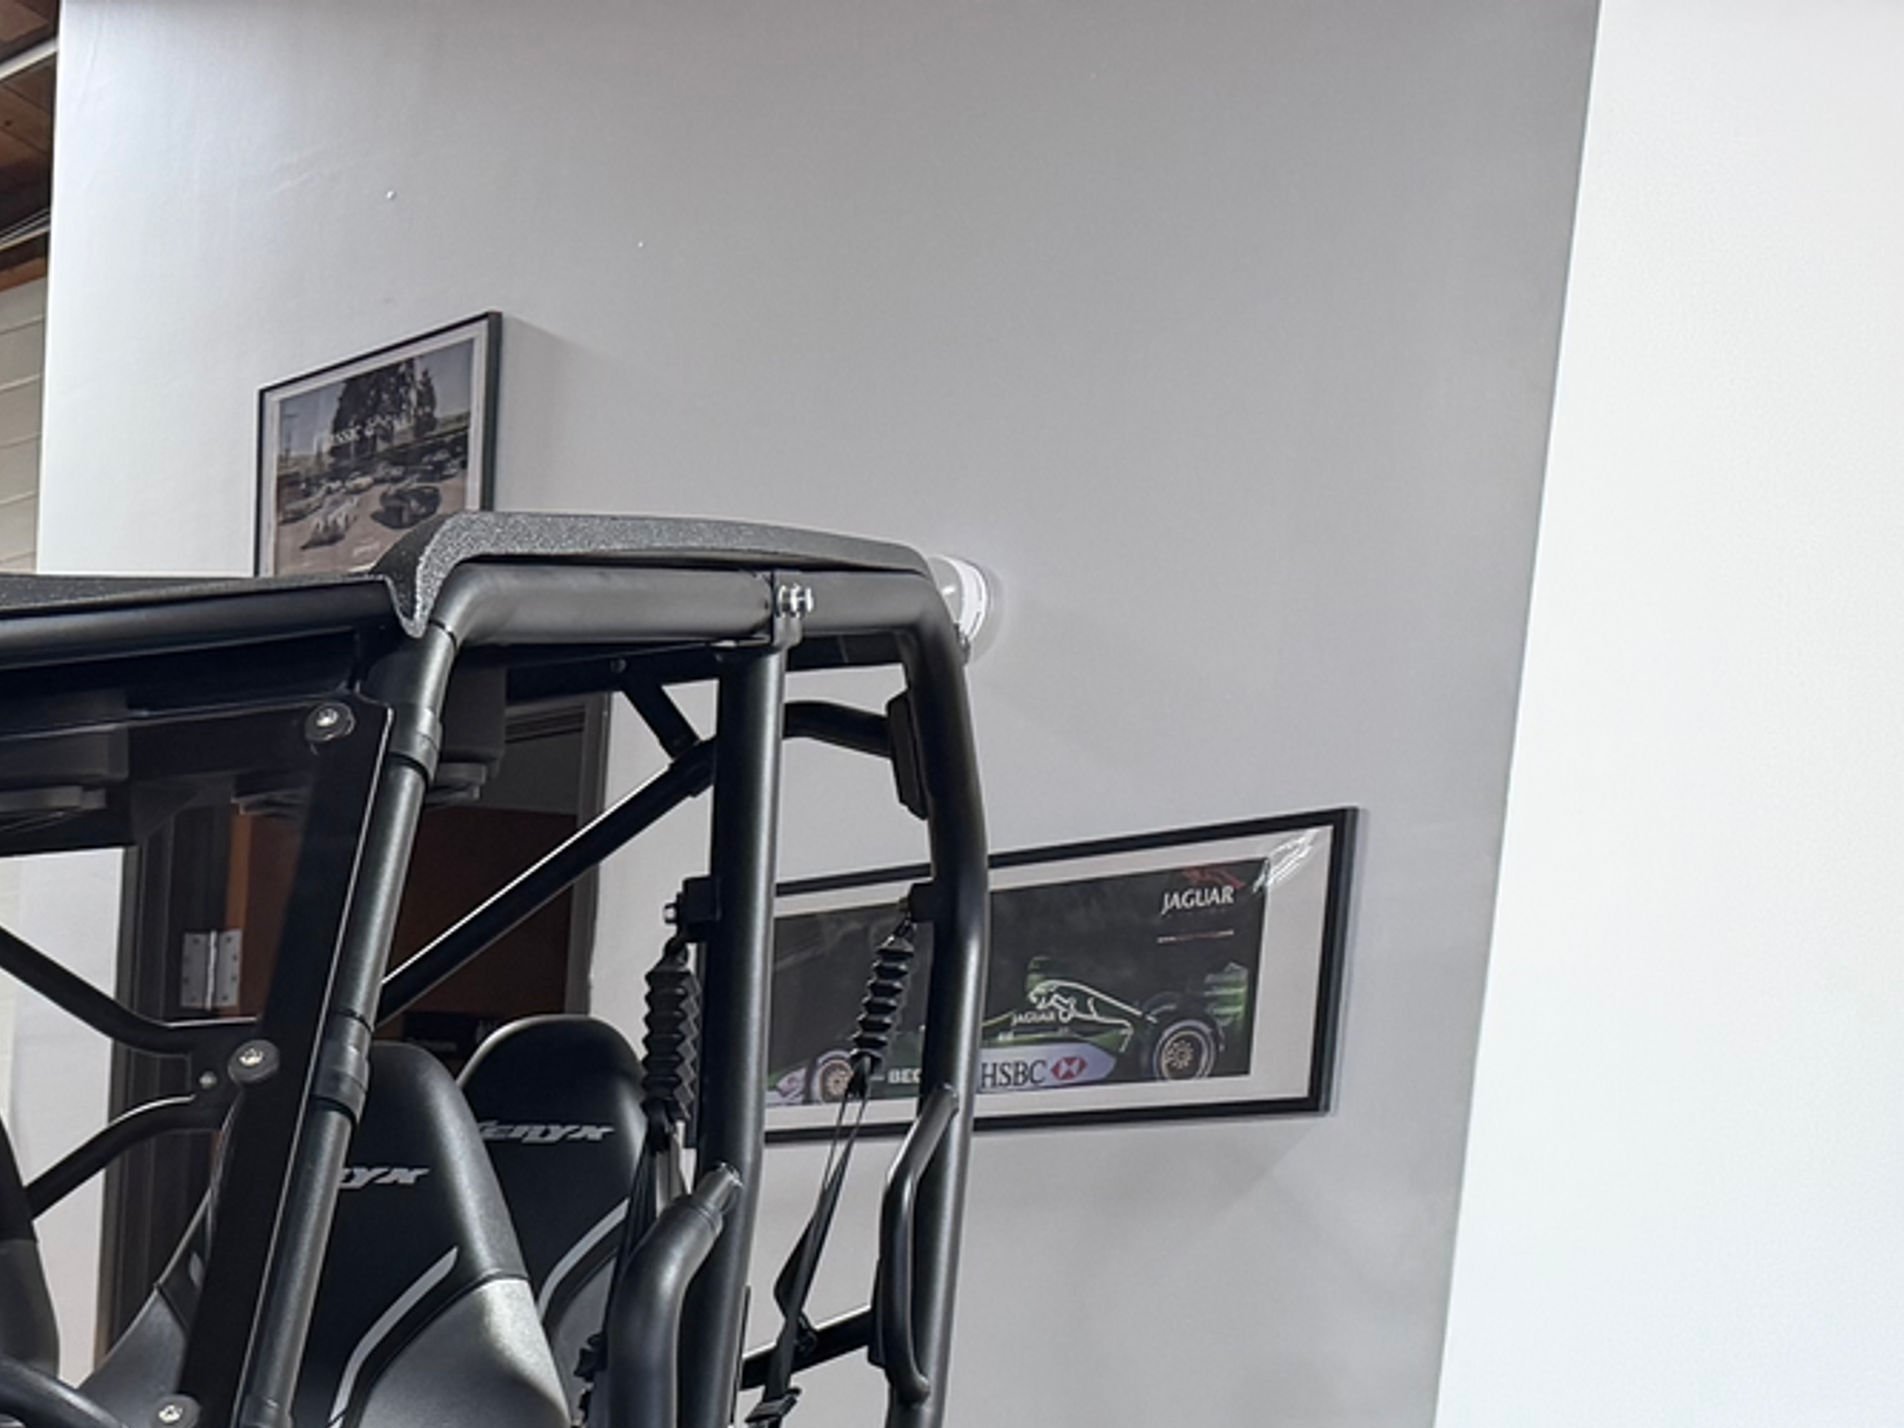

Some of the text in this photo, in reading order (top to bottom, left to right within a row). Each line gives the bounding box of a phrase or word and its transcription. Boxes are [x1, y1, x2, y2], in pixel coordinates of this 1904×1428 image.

[1160, 885, 1235, 915] JAGUAR
[981, 1059, 1047, 1089] HSBC
[478, 1120, 614, 1144] ERYX
